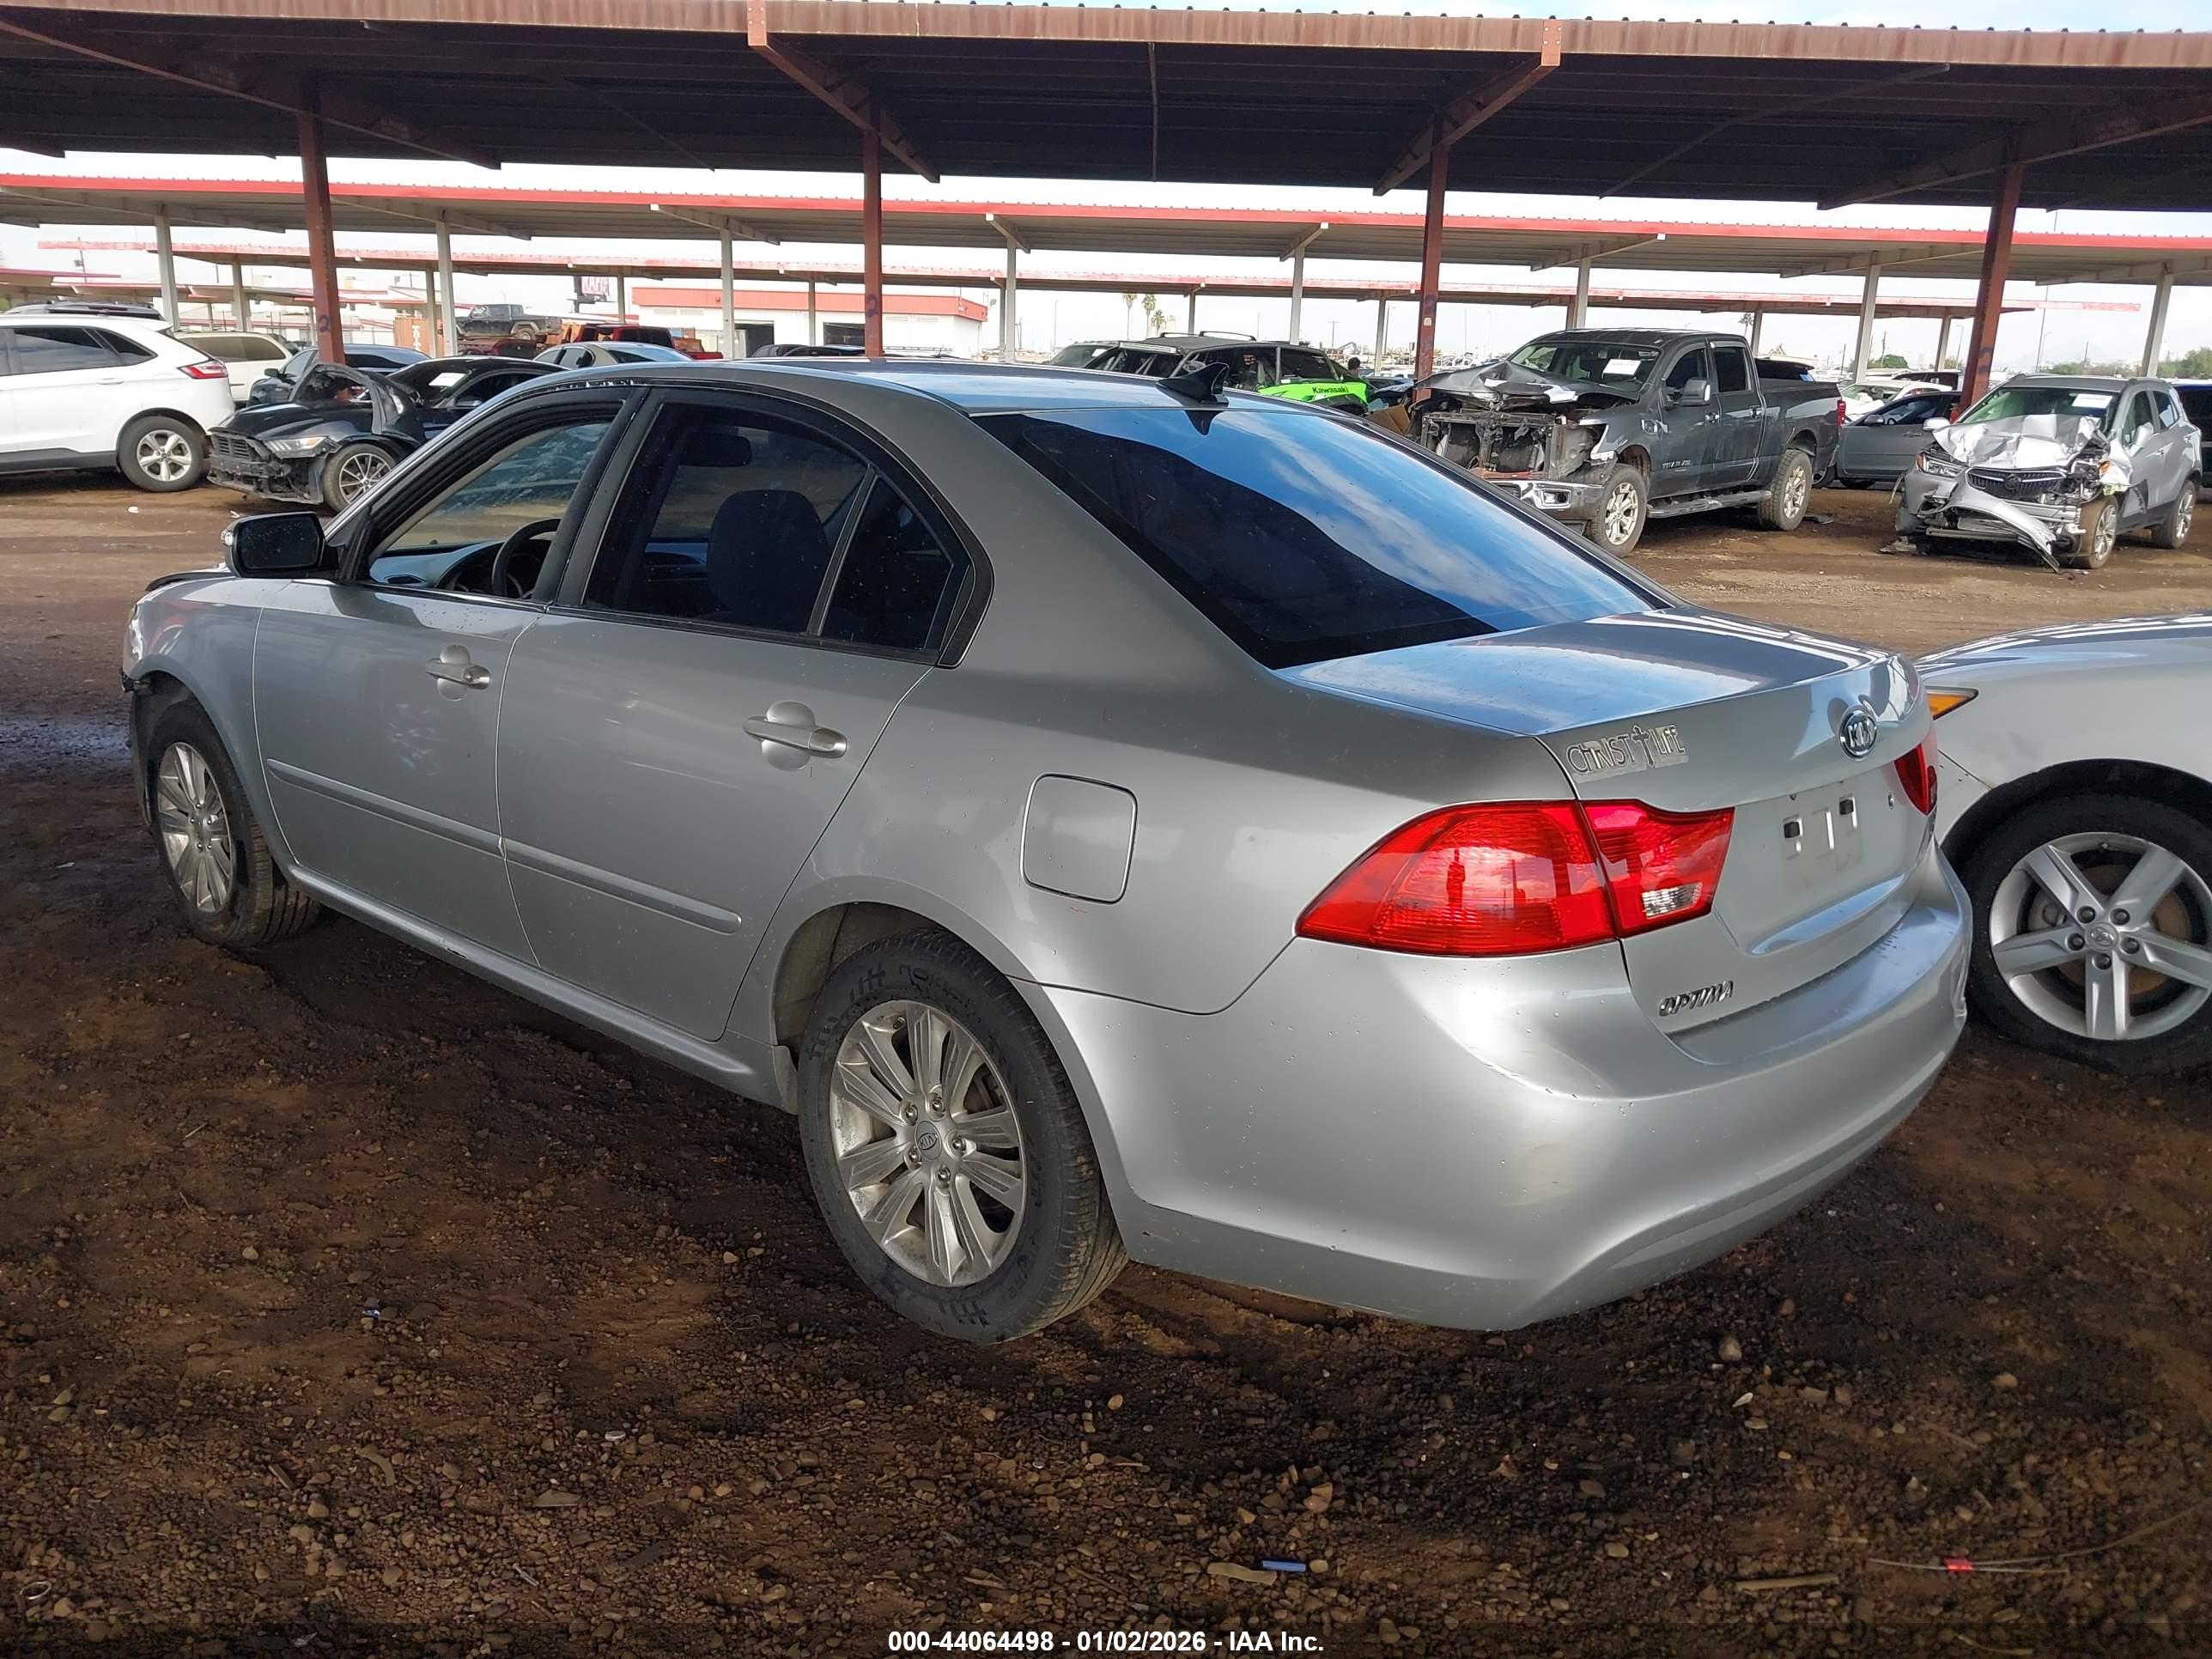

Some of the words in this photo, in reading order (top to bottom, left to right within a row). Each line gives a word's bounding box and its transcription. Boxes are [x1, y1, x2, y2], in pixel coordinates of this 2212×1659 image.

[1312, 386, 1349, 394] Kawasaki
[1847, 718, 1875, 748] KIA
[1659, 980, 1734, 1017] OPTIMA
[919, 1134, 934, 1148] KIA
